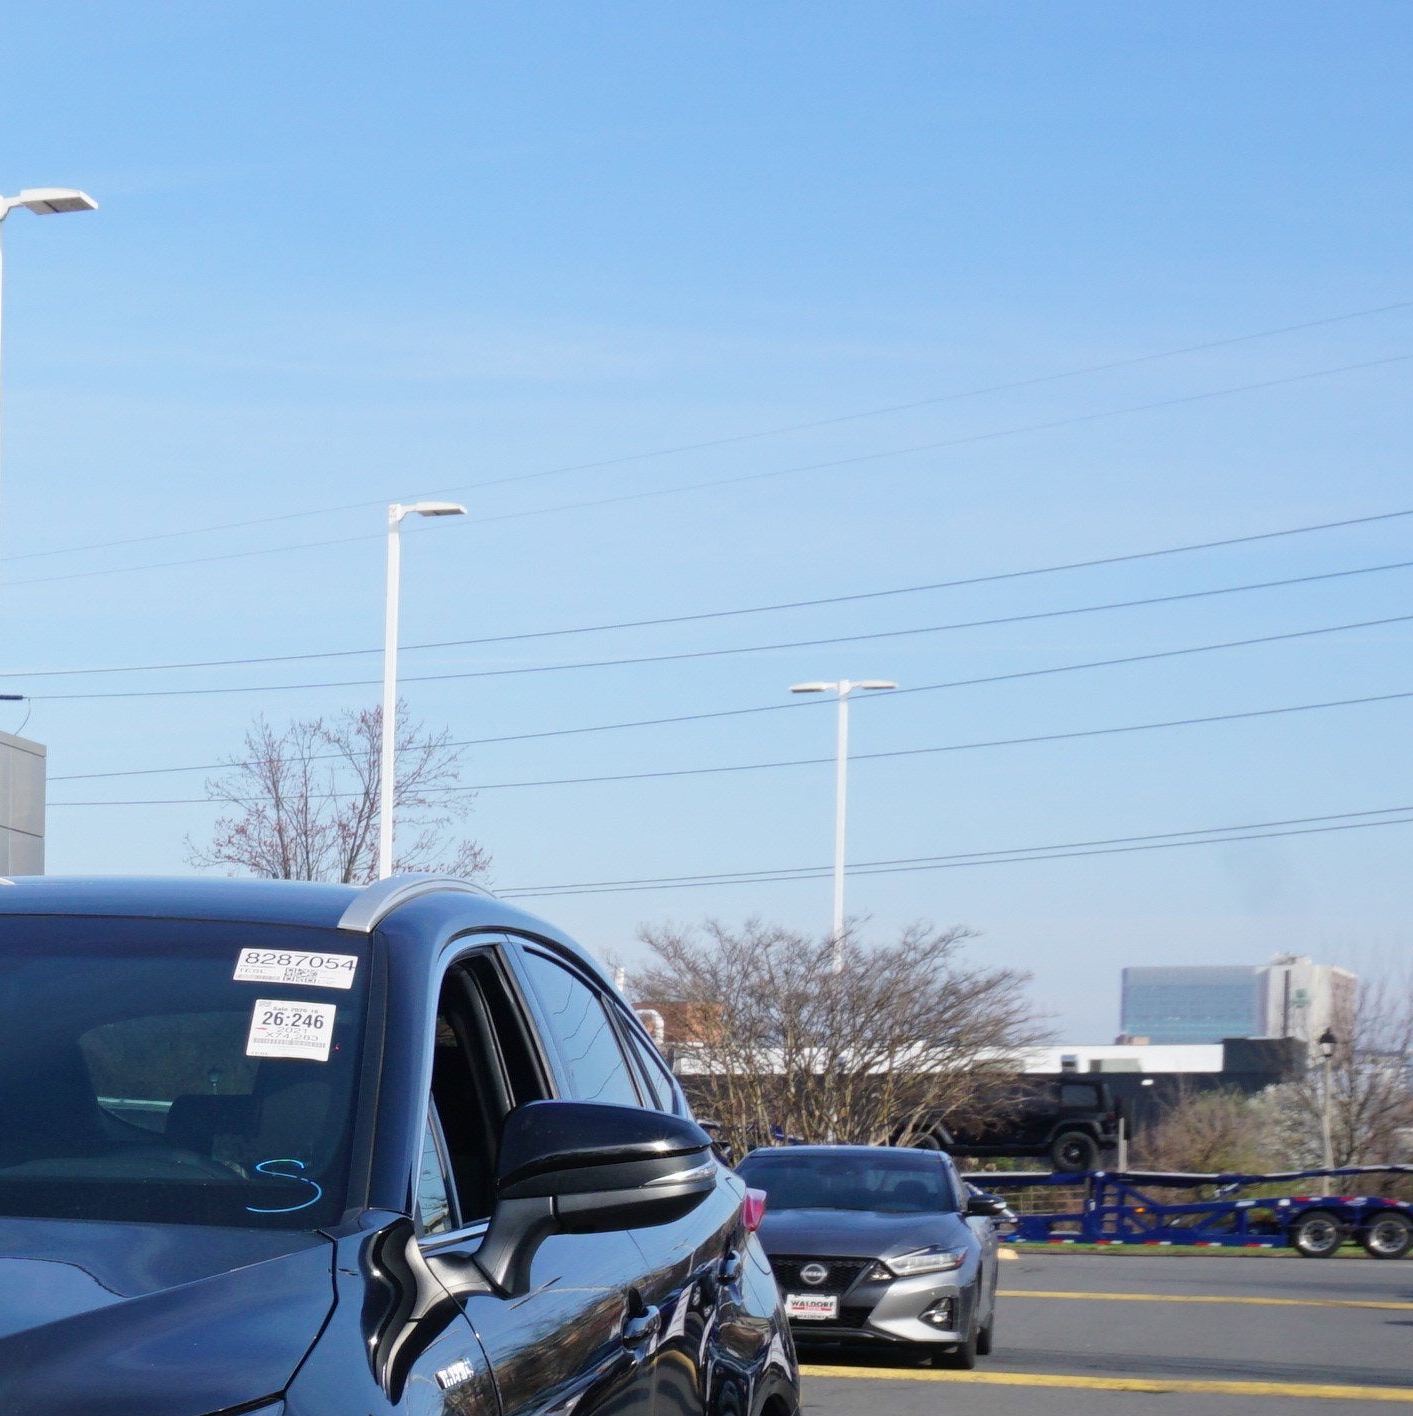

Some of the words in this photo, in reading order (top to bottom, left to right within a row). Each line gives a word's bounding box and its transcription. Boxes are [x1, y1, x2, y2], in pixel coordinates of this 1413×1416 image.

[245, 952, 356, 971] 8287054
[262, 1011, 324, 1029] 26:246
[277, 1026, 307, 1034] 2021
[791, 1300, 835, 1308] WALDORF
